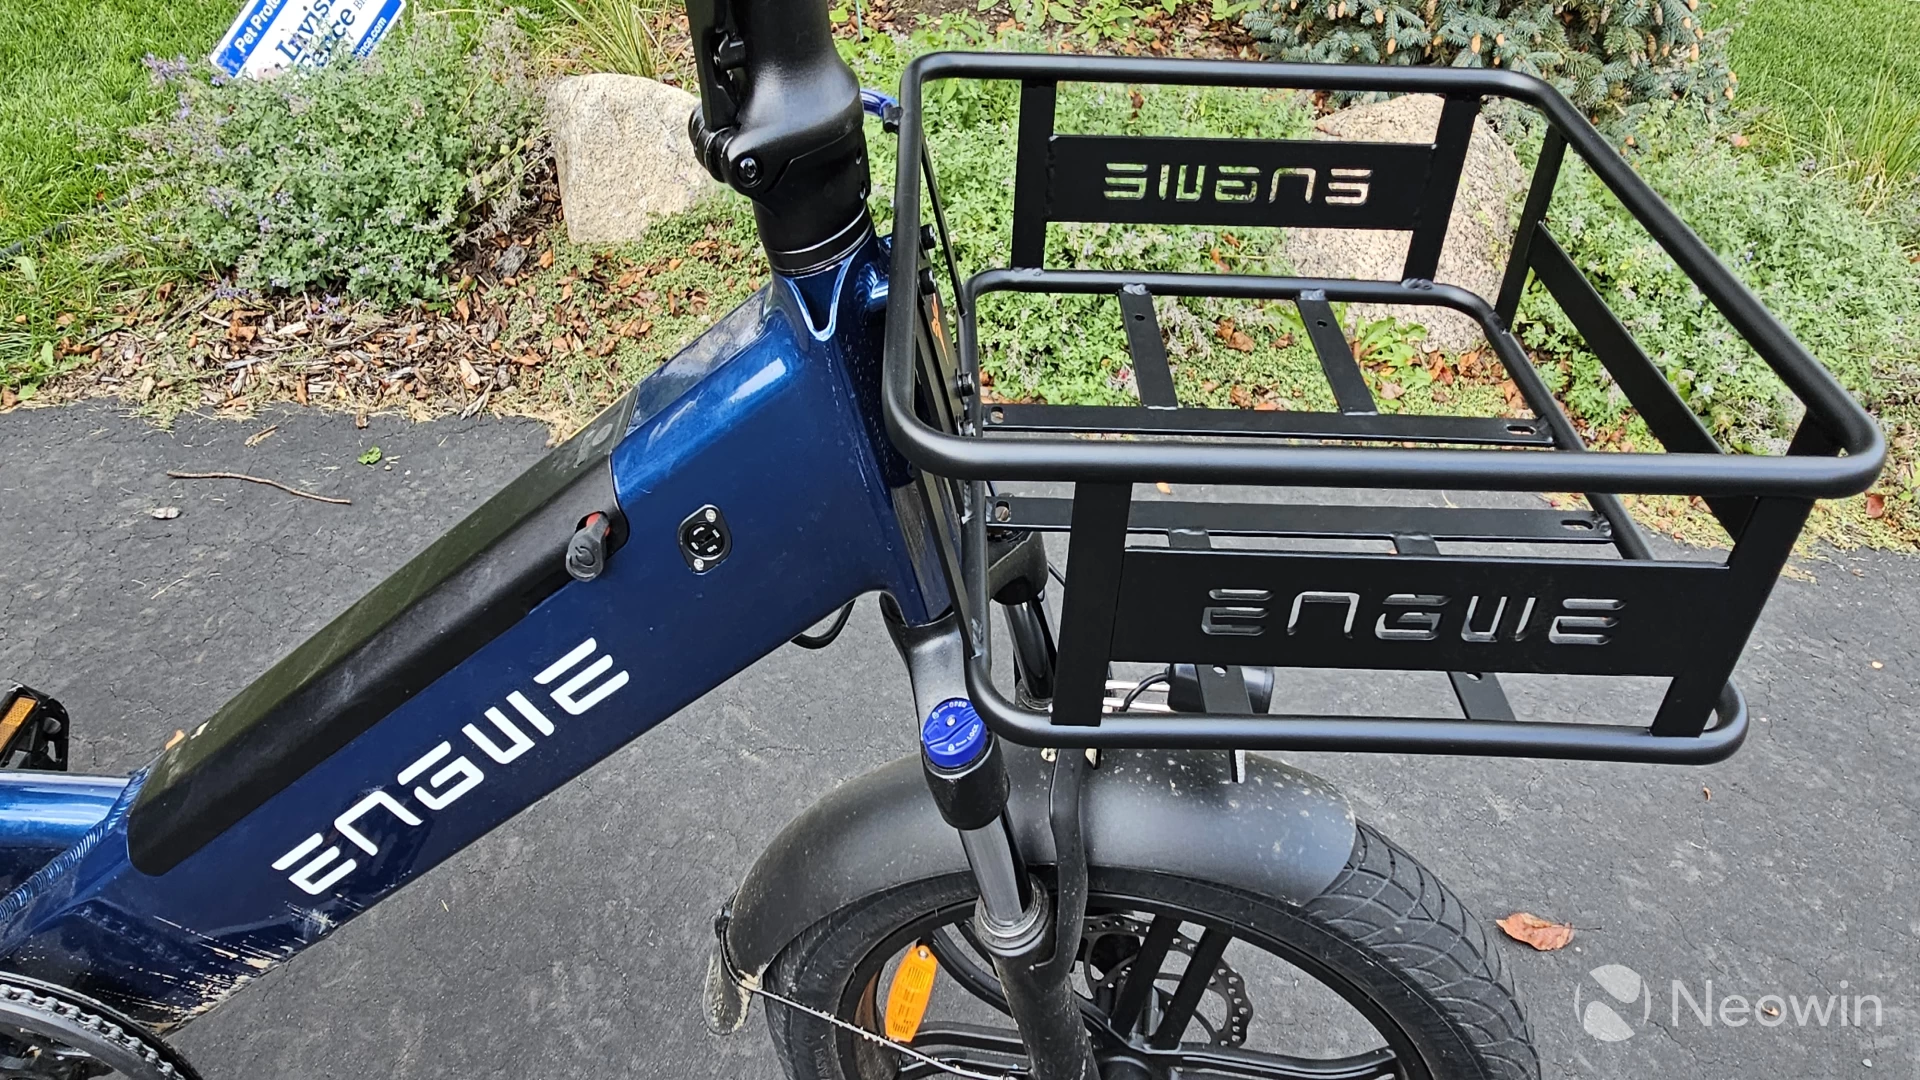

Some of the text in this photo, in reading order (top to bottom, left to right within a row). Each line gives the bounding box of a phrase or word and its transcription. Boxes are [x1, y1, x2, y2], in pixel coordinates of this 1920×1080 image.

[234, 26, 258, 54] Pet
[275, 0, 336, 61] Invis
[1200, 587, 1627, 646] ENGWE
[948, 701, 968, 709] OPEN
[966, 723, 979, 741] LOCK
[271, 637, 630, 895] ENGWE
